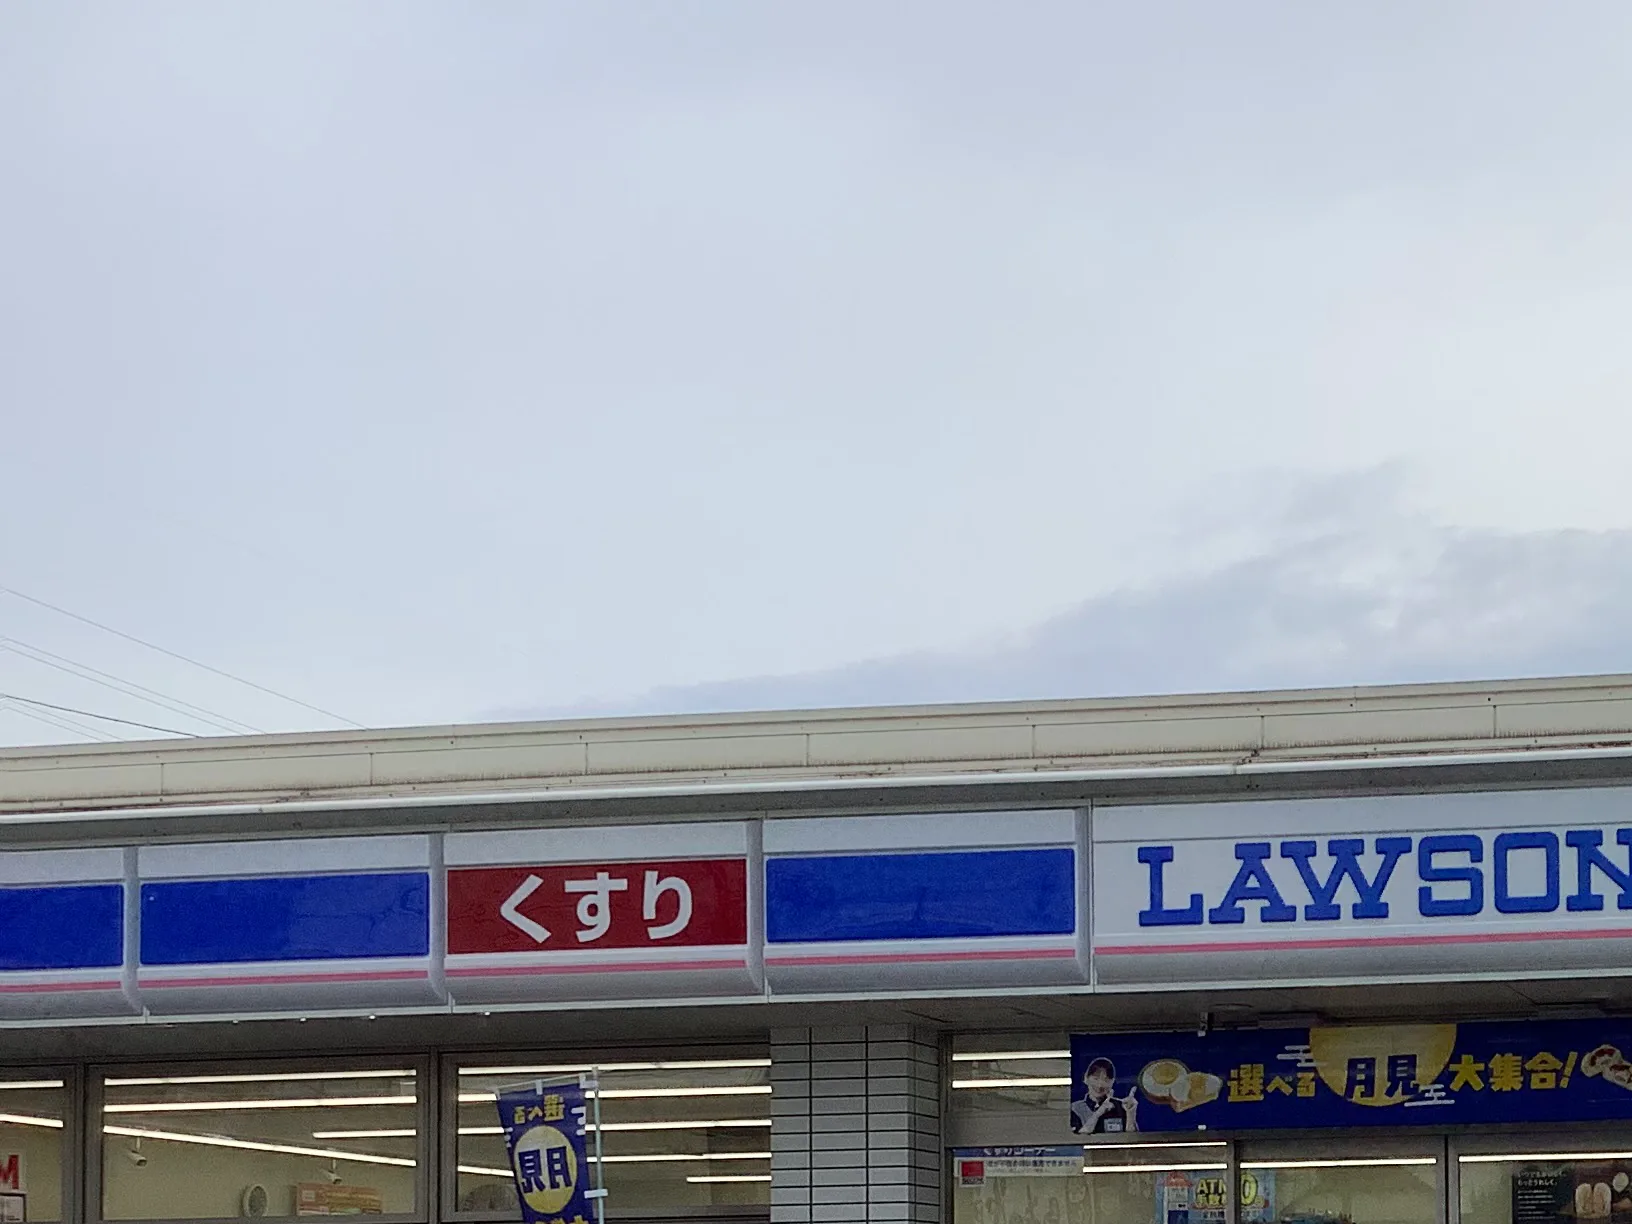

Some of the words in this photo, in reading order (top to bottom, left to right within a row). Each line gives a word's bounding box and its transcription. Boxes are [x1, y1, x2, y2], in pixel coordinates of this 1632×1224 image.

[499, 869, 694, 945] くすり
[1227, 1066, 1317, 1102] 選べる
[1345, 1053, 1419, 1099] 月見
[1448, 1050, 1578, 1094] 大集合!
